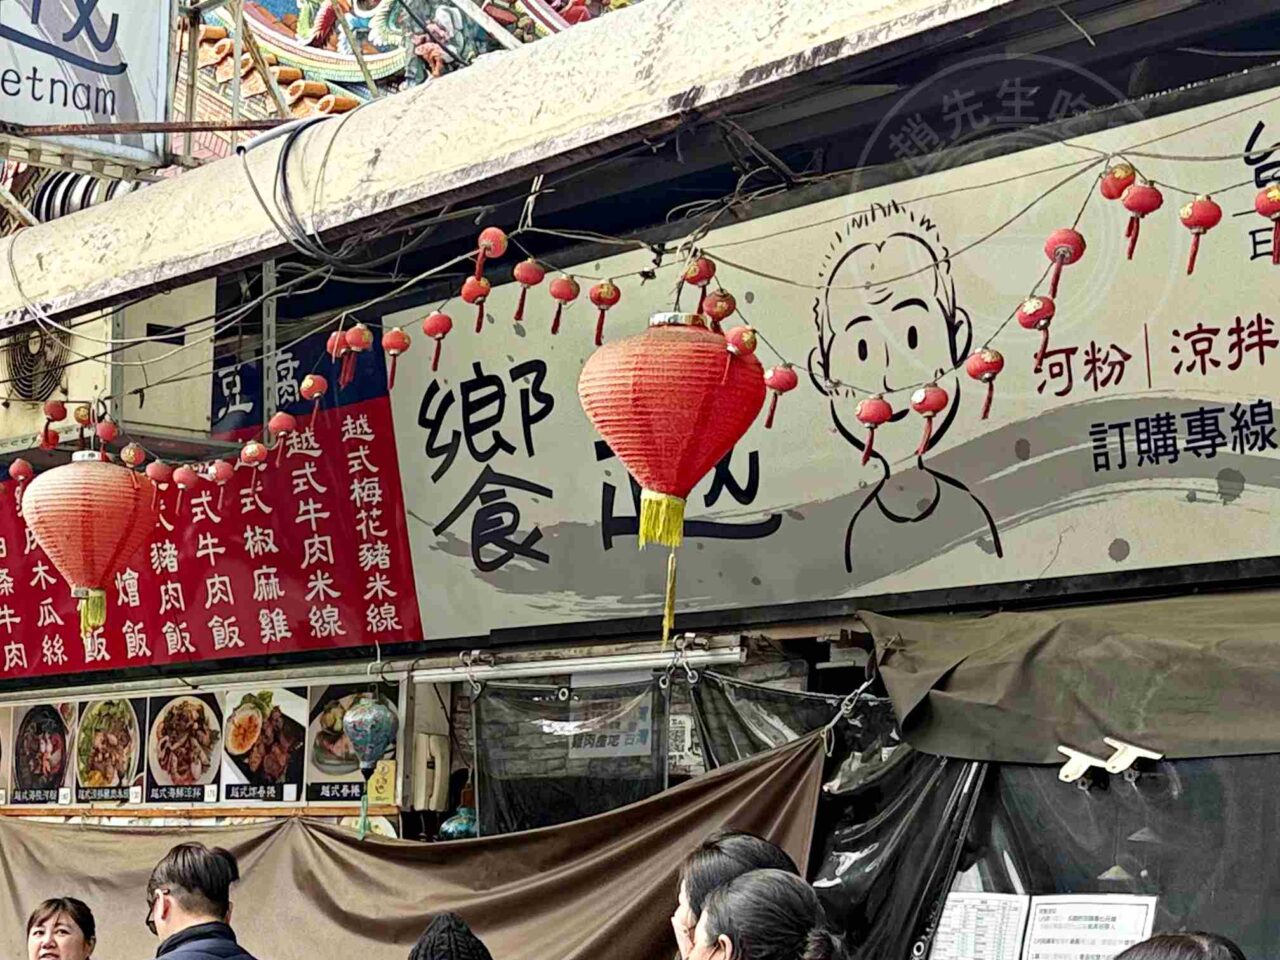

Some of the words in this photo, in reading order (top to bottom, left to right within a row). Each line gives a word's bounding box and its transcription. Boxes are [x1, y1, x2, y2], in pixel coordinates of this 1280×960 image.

[1036, 340, 1132, 398] 河粉
[1170, 313, 1279, 376] 涼拌
[1089, 399, 1278, 472] 訂購專線
[285, 427, 347, 639] 越式牛肉米線
[341, 413, 404, 634] 越式梅花豬米線
[320, 784, 361, 797] 越式春捲
